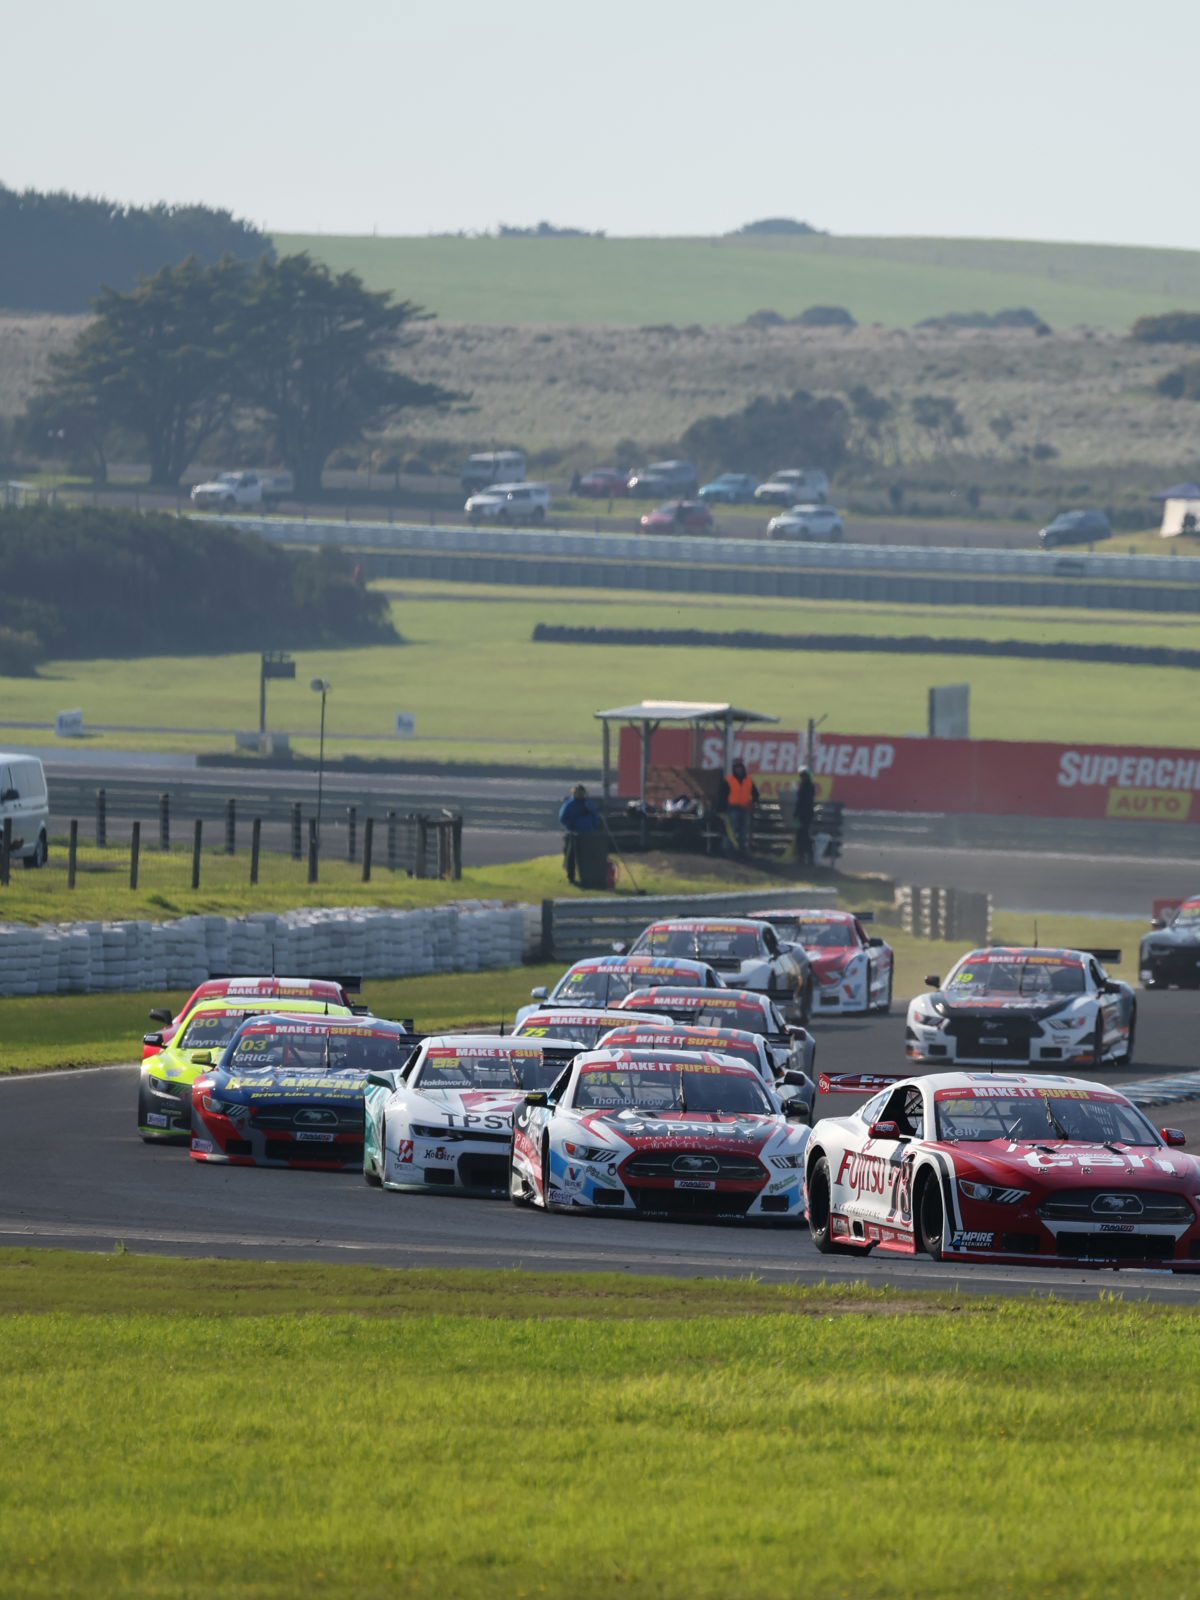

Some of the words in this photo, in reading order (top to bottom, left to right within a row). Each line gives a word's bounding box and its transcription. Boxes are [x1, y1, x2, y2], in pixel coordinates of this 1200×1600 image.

[1117, 796, 1181, 812] AUTO
[640, 968, 675, 976] SUPER
[276, 988, 314, 996] SUPER
[585, 1017, 598, 1025] IT
[600, 1018, 640, 1026] SUPER
[276, 1026, 312, 1034] MAKE
[315, 1026, 328, 1034] IT
[330, 1027, 373, 1036] SUPER
[523, 1028, 550, 1037] 75
[636, 1035, 671, 1044] MAKE
[673, 1036, 685, 1045] IT
[687, 1038, 728, 1047] SUPER
[235, 1053, 275, 1062] GRICE
[456, 1049, 495, 1057] MAKE
[498, 1049, 511, 1057] IT
[616, 1062, 656, 1071] MAKE
[659, 1063, 672, 1071] IT
[675, 1064, 721, 1074] SUPER
[225, 1077, 274, 1090] ALL
[972, 1088, 1017, 1097] MAKE
[1019, 1088, 1036, 1097] IT
[1038, 1088, 1090, 1099] SUPER
[591, 1096, 665, 1106] Thornburrow
[624, 1122, 763, 1134] SYDNEY
[942, 1127, 981, 1139] Kelly
[834, 1149, 887, 1201] FUJITSU
[953, 1231, 995, 1244] EMPIRE
